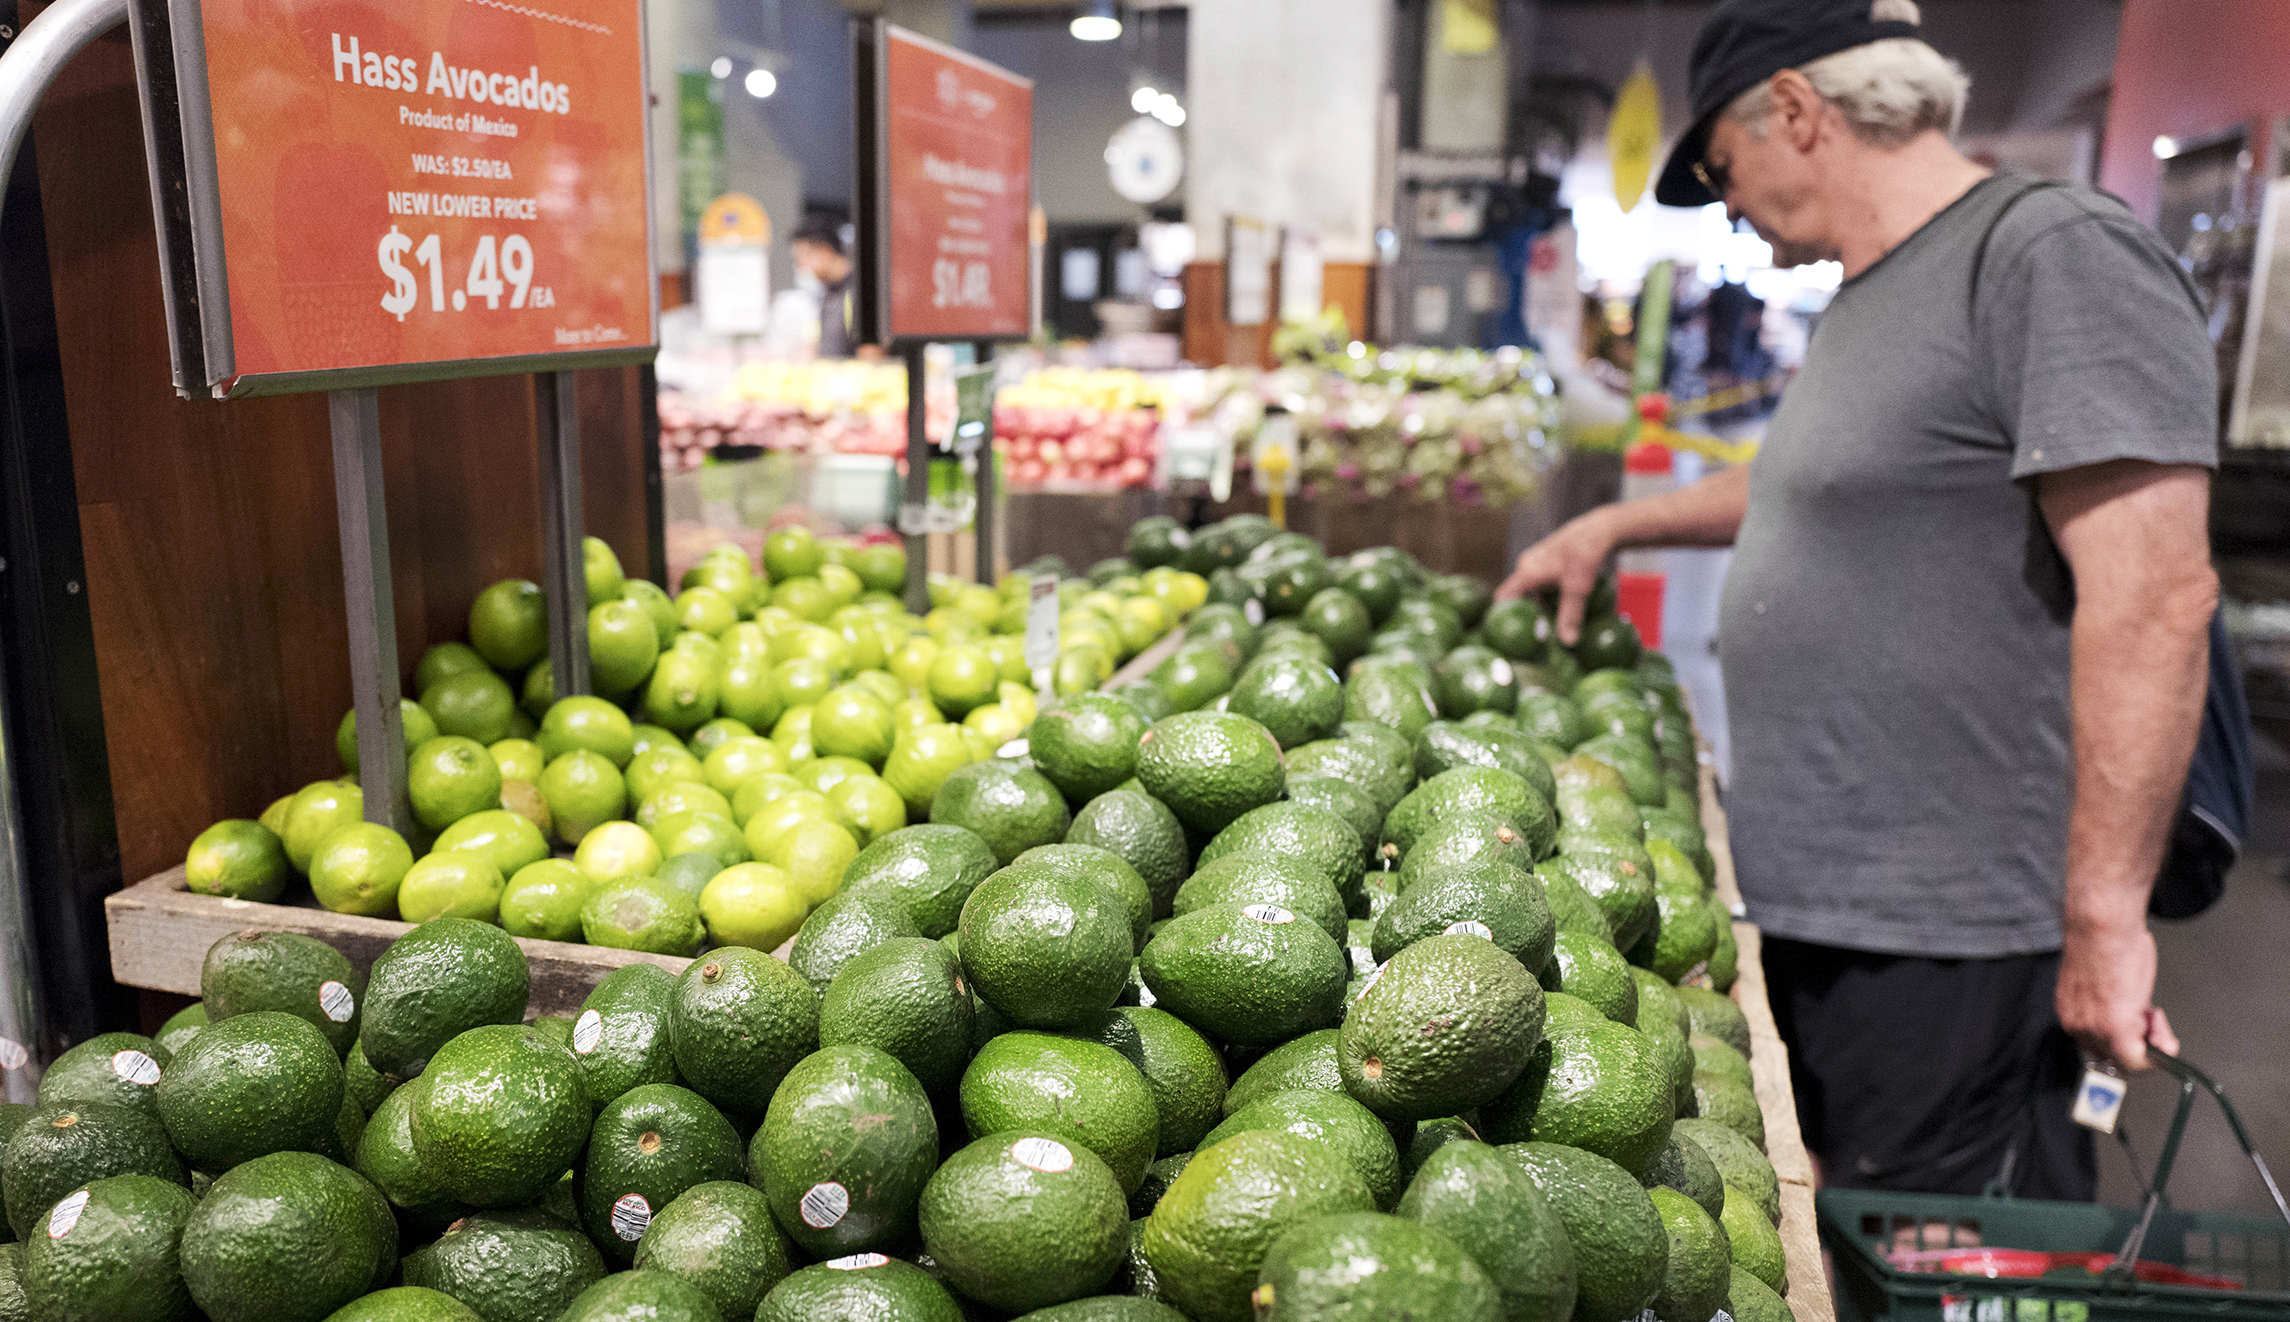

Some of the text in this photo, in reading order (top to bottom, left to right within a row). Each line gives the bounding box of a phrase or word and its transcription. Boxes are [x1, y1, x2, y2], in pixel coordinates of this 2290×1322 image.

[331, 32, 571, 115] Hass Avocados
[399, 105, 518, 138] Product of Mexico
[411, 153, 513, 180] WAS: $2.50/EA
[387, 191, 538, 220] NEW LOWER PRICE
